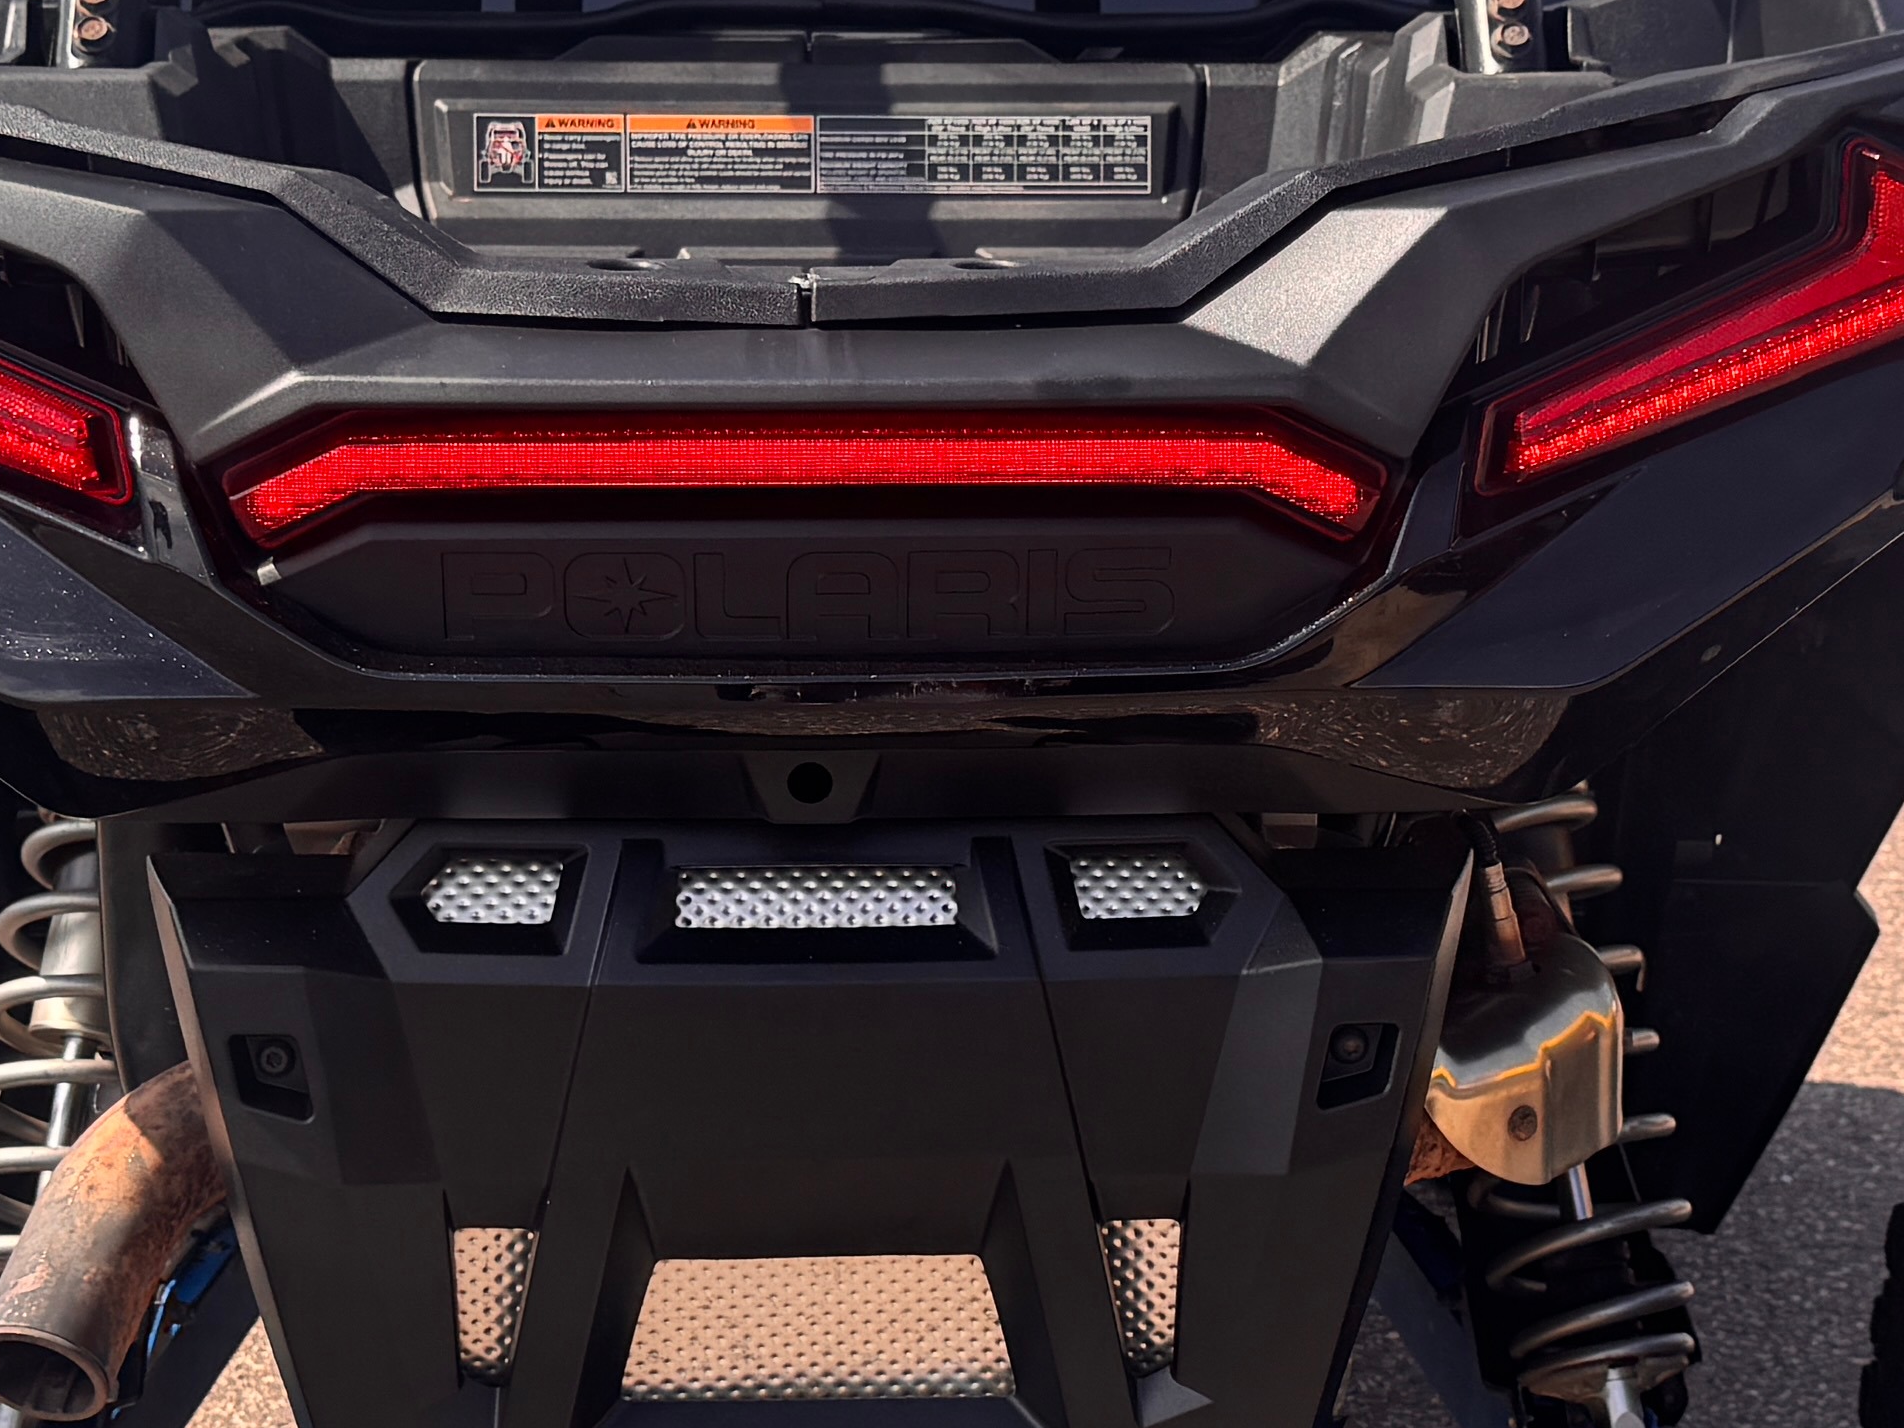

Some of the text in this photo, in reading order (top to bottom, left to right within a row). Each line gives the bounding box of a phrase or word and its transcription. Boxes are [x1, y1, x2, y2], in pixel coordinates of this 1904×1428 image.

[558, 118, 615, 128] WARNING
[698, 119, 756, 129] WARNING
[440, 546, 1176, 641] POLARIS
